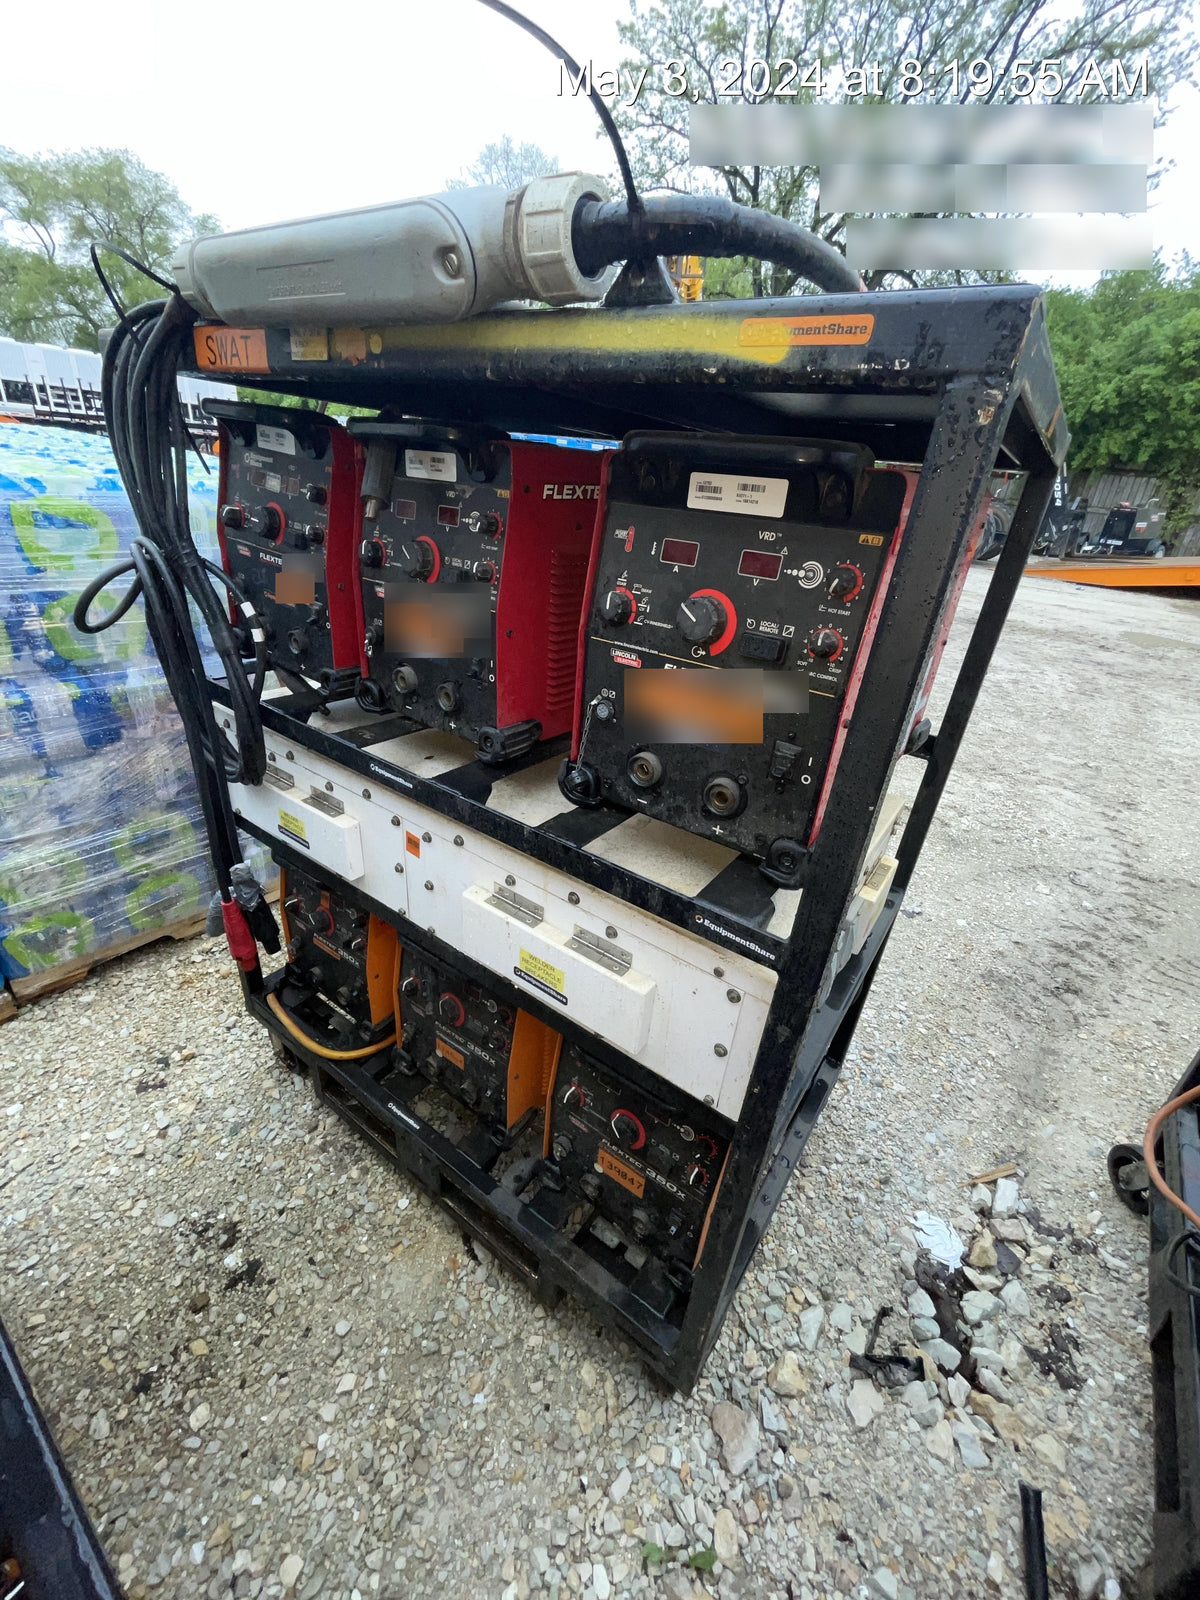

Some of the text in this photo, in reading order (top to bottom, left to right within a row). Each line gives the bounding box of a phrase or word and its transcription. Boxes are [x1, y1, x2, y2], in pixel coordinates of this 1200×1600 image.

[205, 334, 251, 366] SWAT
[611, 649, 637, 661] LINCOLN
[703, 918, 776, 961] EquipmentShare
[521, 956, 562, 984] RECEPTACLE
[528, 952, 556, 973] WELDER
[601, 1138, 643, 1169] FLEXTEC
